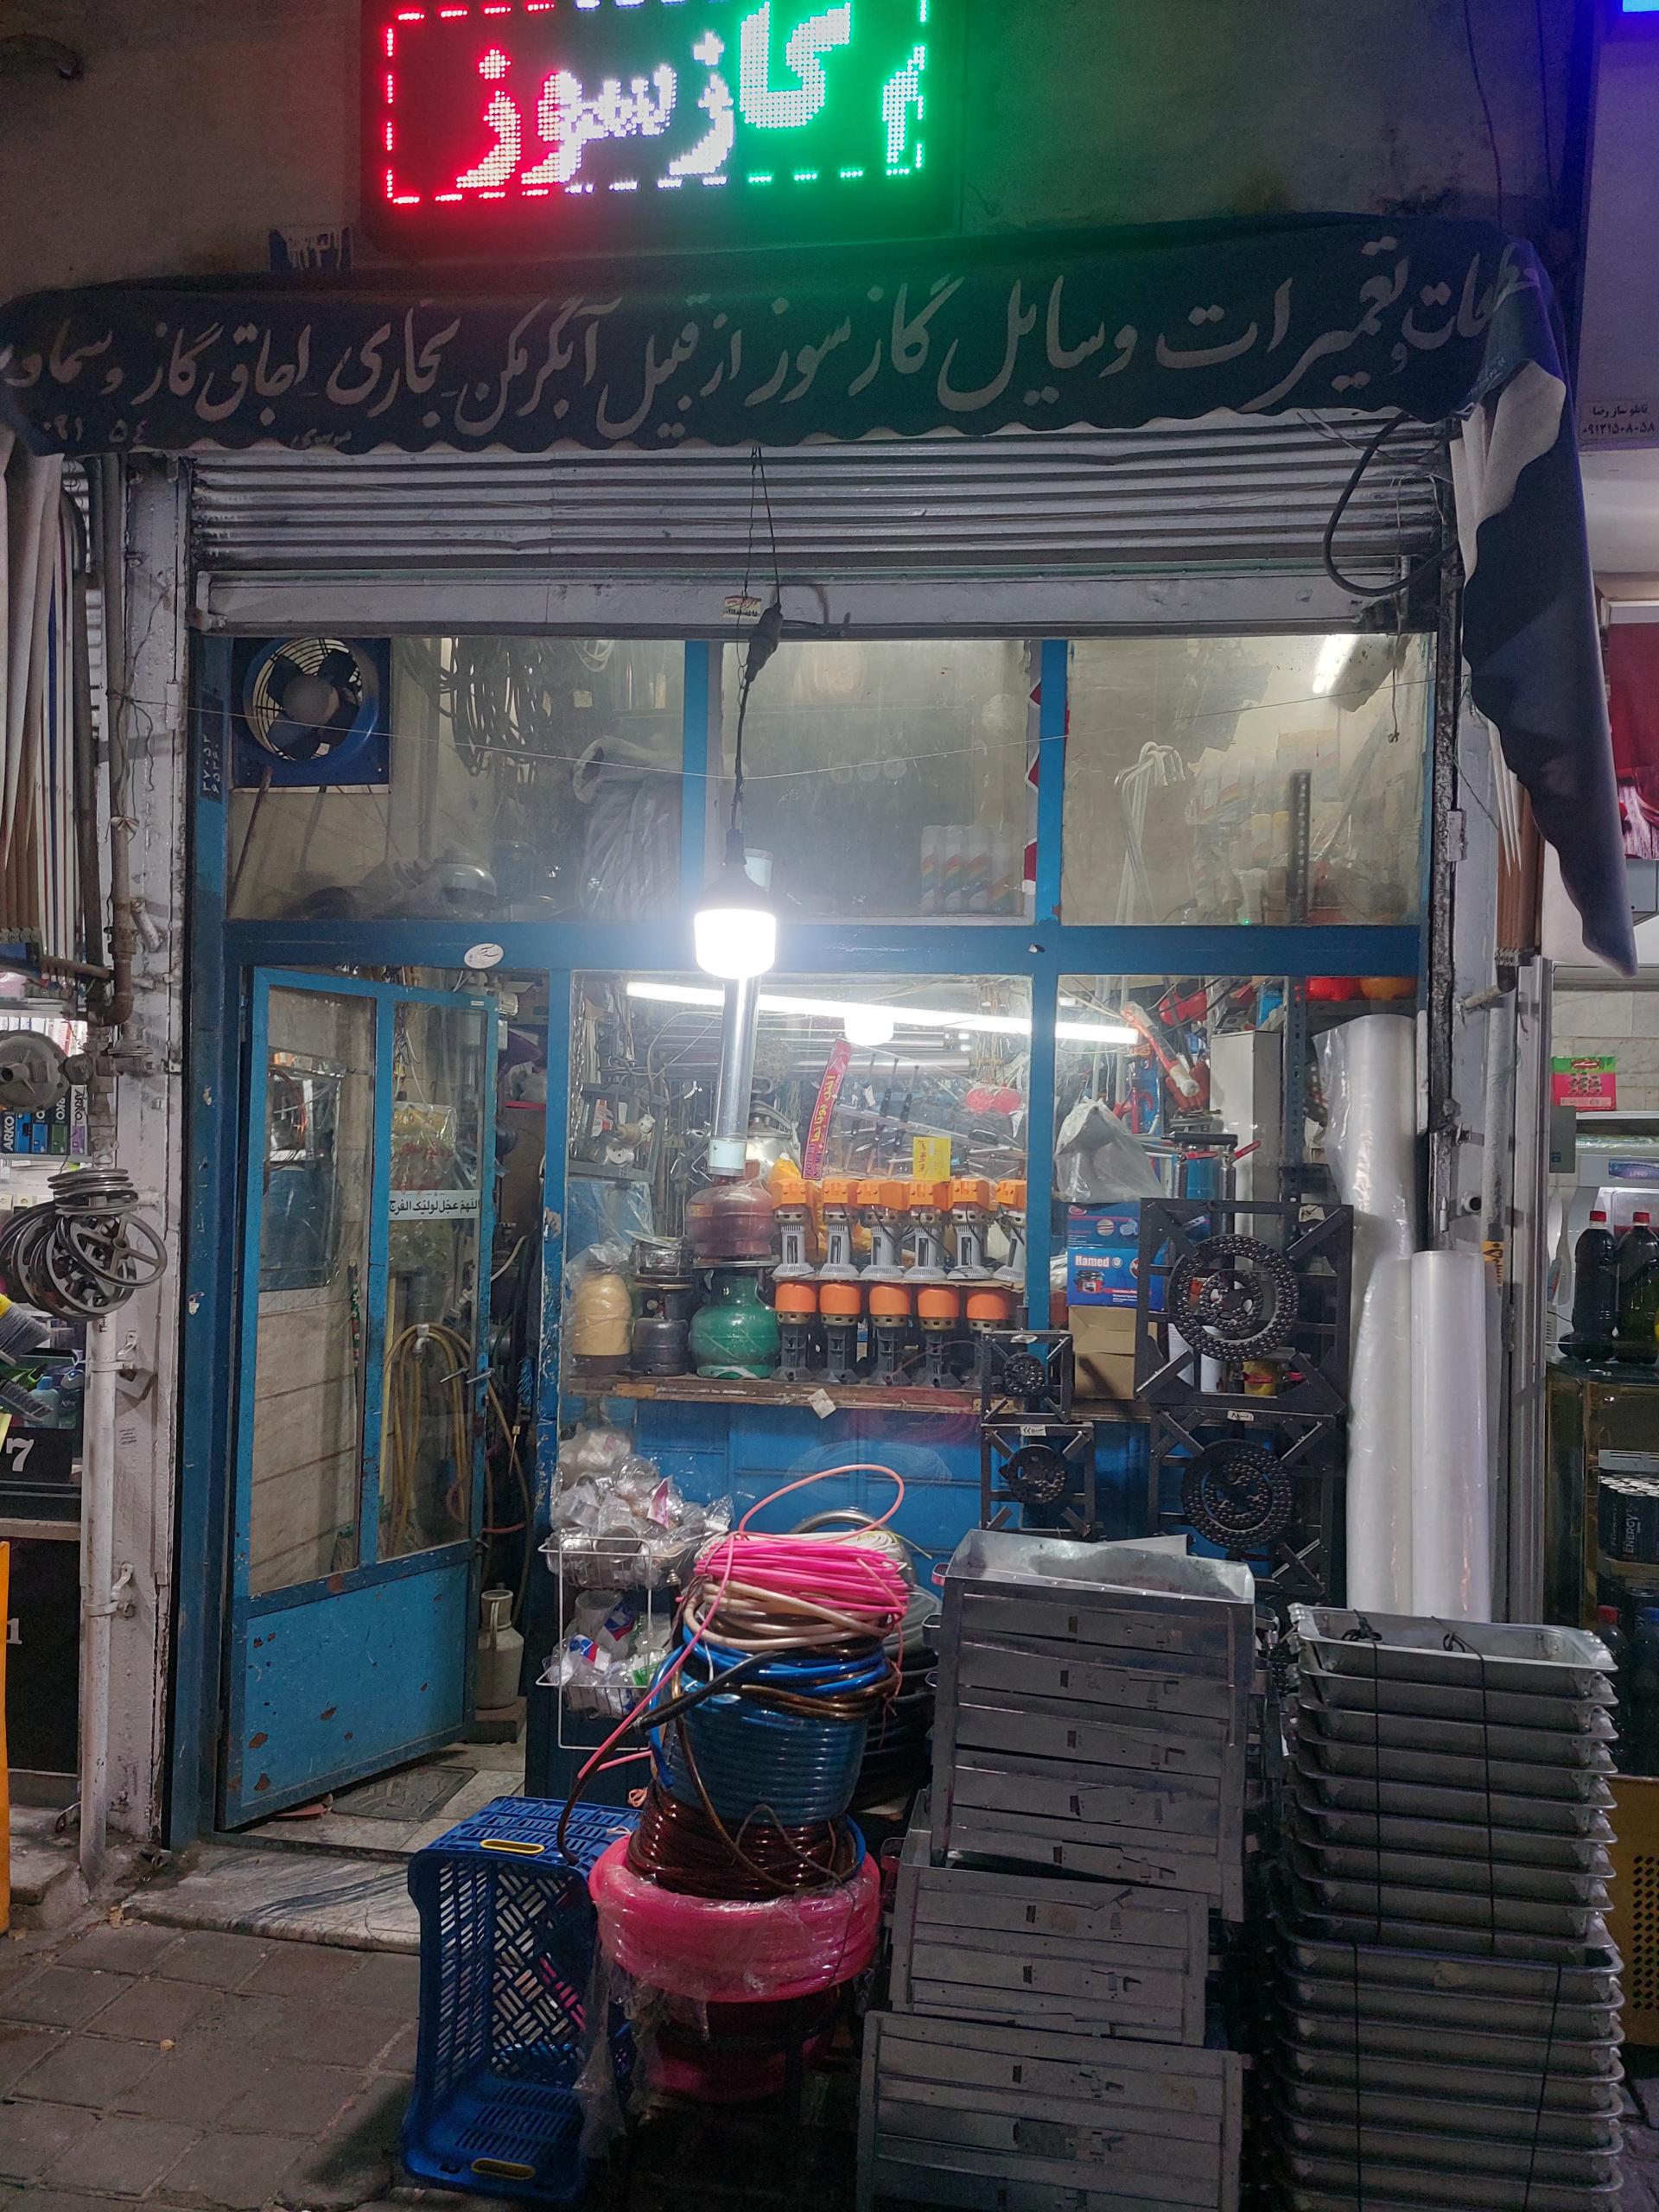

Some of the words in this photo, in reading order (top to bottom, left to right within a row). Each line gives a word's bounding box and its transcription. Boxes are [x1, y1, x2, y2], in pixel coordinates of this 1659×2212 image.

[744, 296, 852, 408] سوز
[847, 273, 966, 397] گاز
[130, 320, 225, 406] گاز
[700, 313, 743, 398] از
[99, 366, 124, 395] و
[73, 1089, 83, 1122] ARKO
[3, 1116, 16, 1151] ARKO
[6, 1437, 35, 1472] 7
[1626, 1514, 1638, 1553] ENERGY
